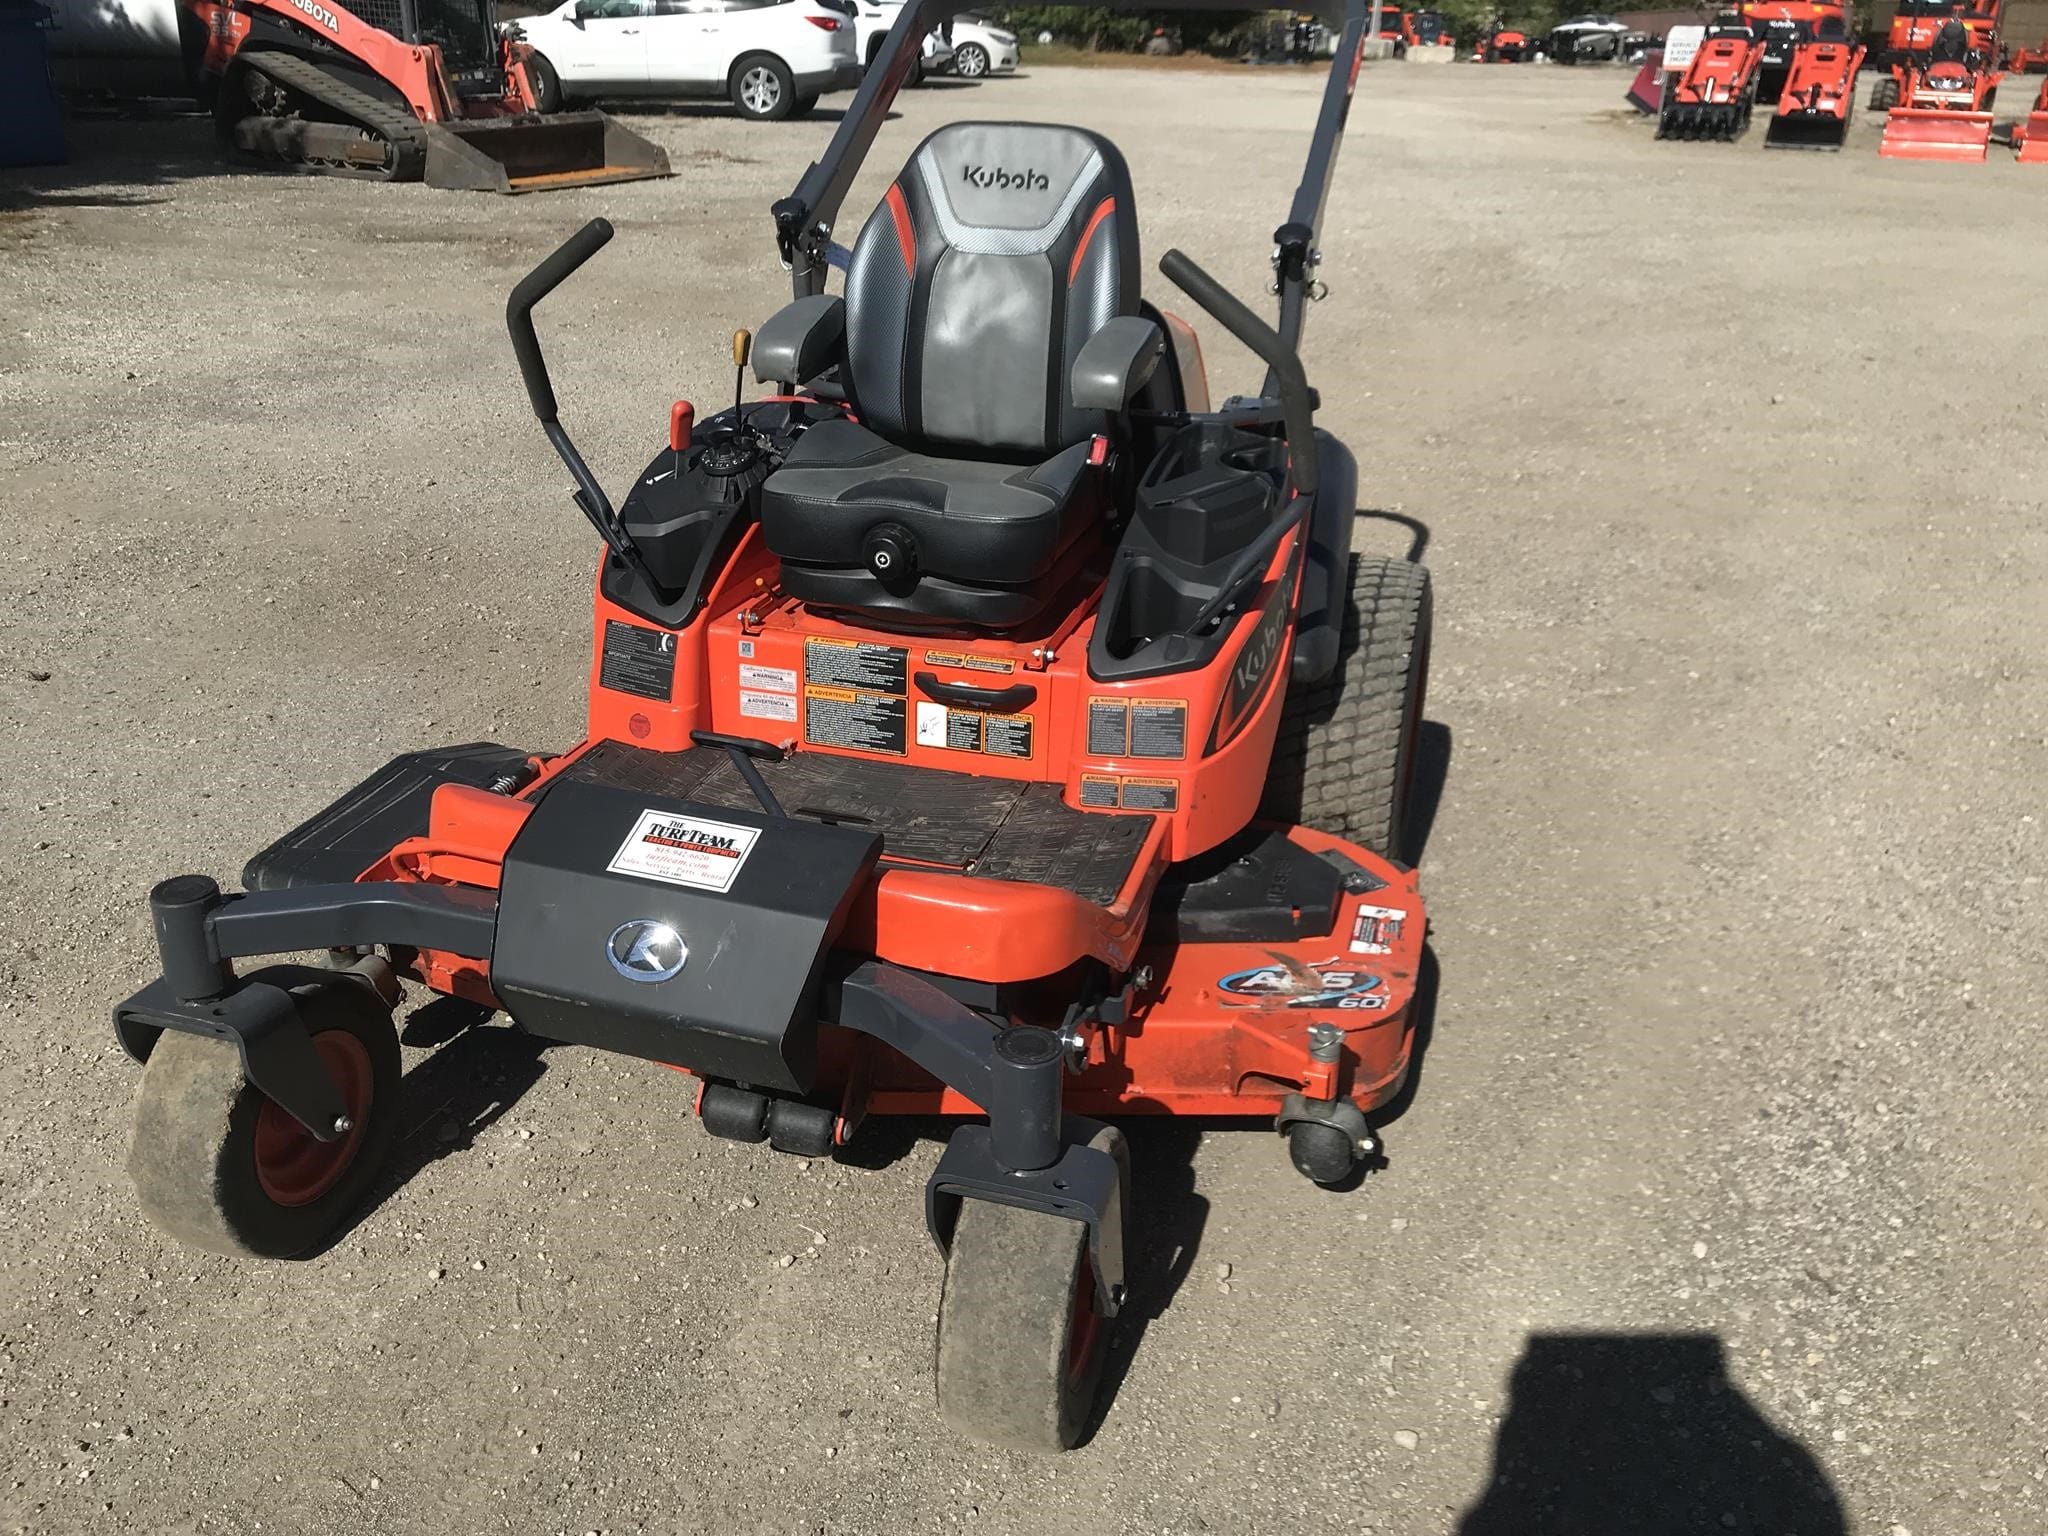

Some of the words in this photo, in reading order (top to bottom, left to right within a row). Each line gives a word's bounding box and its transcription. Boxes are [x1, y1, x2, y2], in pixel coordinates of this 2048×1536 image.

[210, 11, 242, 27] SVL
[290, 0, 339, 33] UBOTA
[964, 165, 1049, 190] Kubota
[669, 820, 685, 829] THE
[1338, 997, 1383, 1009] 60
